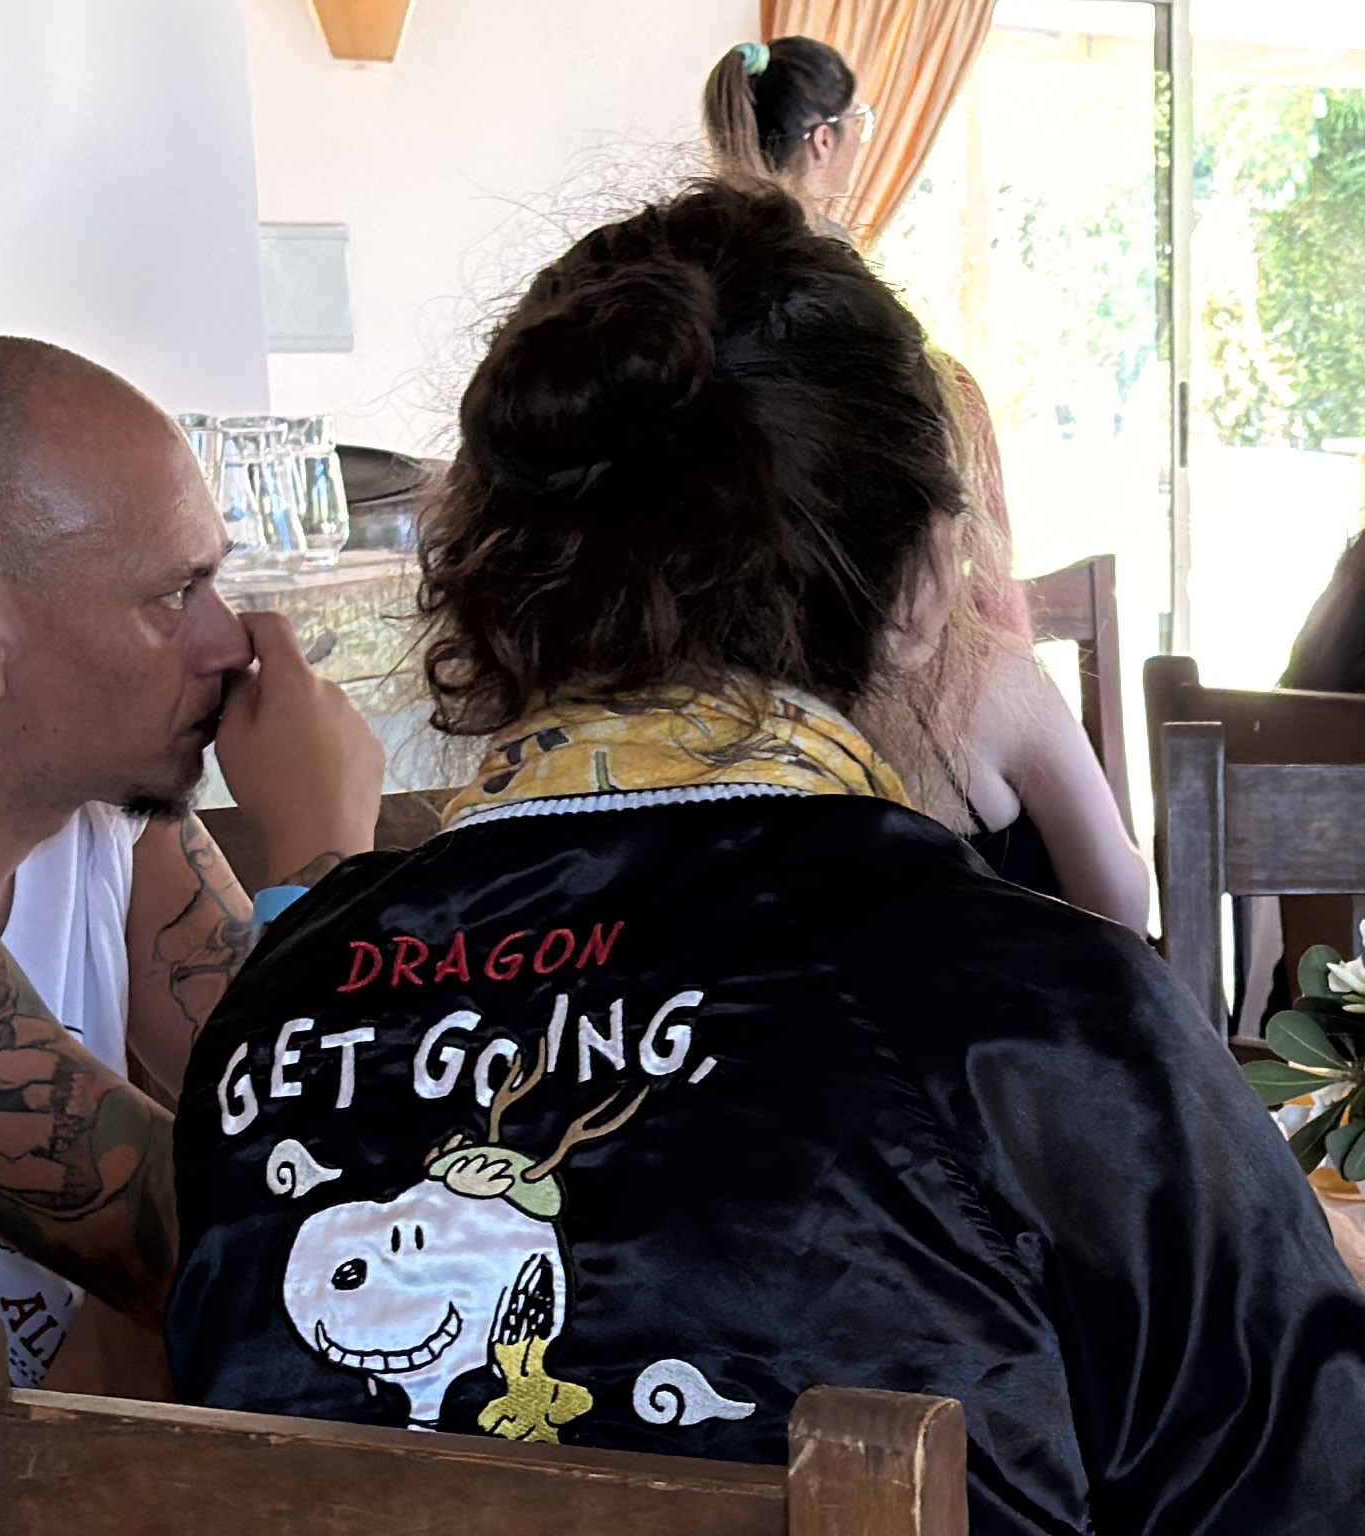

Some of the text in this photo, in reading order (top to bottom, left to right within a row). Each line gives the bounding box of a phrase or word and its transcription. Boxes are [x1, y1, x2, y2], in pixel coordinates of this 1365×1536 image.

[336, 920, 625, 993] DRAGON
[216, 990, 717, 1136] GET GOING,
